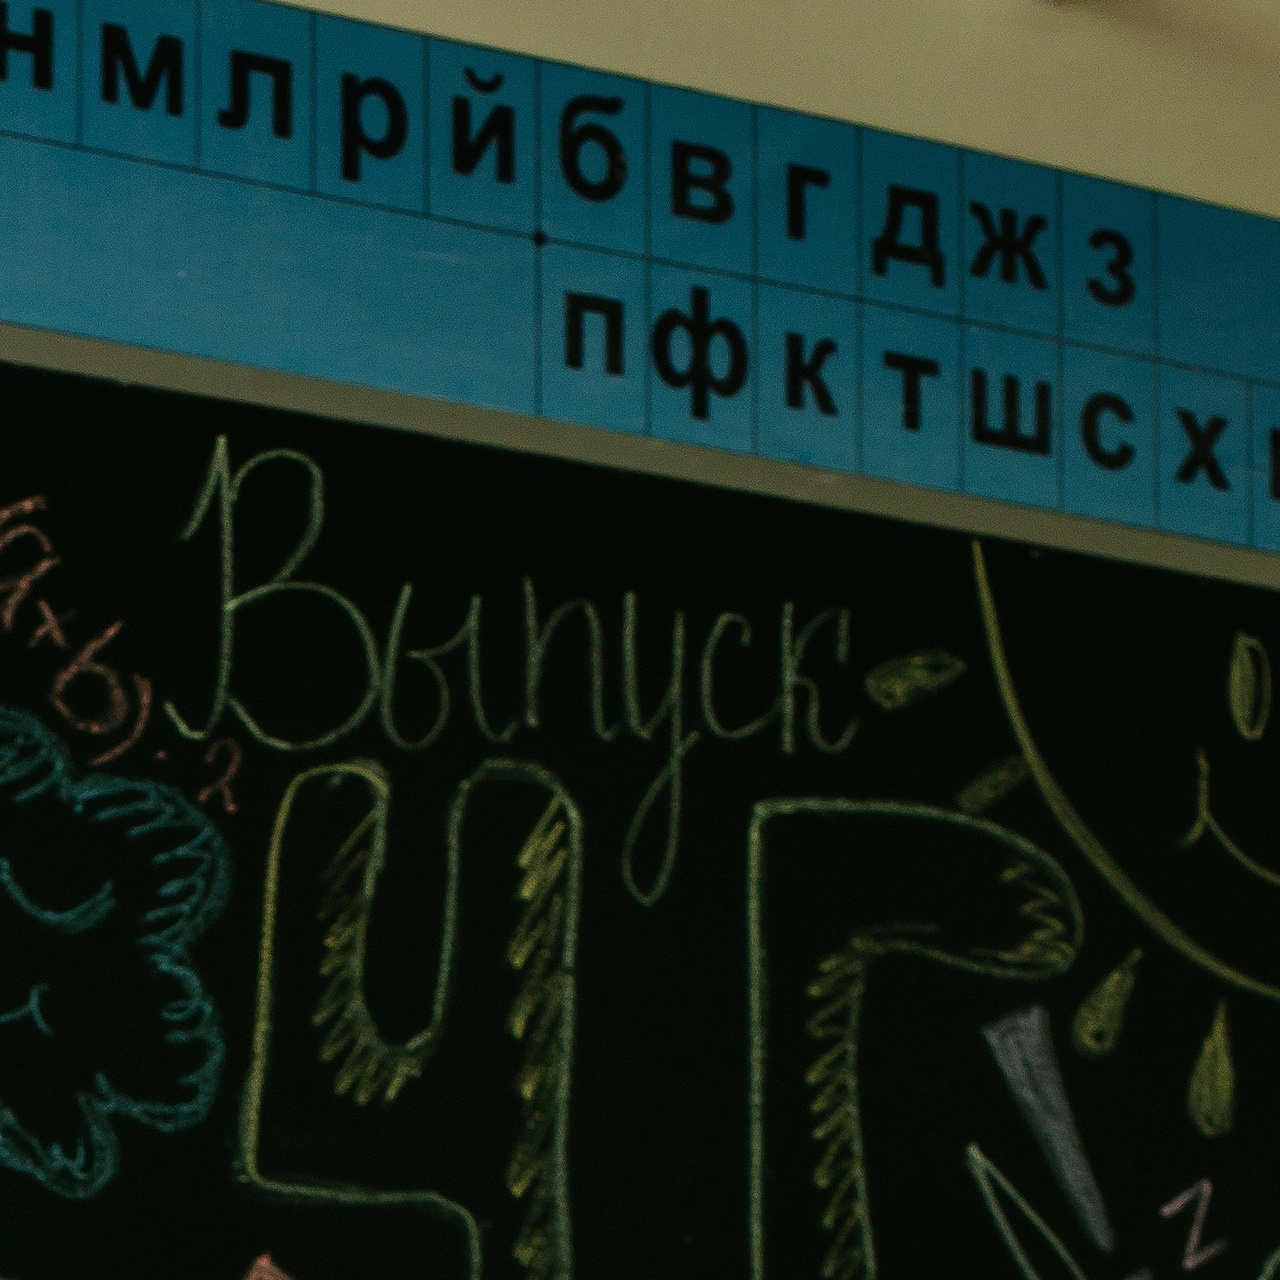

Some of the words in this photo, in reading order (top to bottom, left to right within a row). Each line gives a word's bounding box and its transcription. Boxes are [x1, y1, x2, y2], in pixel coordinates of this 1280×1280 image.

[101, 23, 183, 117] м
[217, 50, 292, 139] л
[340, 73, 408, 182] р
[452, 67, 515, 184] й
[559, 95, 627, 203] б
[671, 141, 734, 224] в
[786, 163, 830, 241] г
[872, 185, 945, 288] д
[970, 202, 1048, 291] ж
[1087, 229, 1136, 307] з
[565, 291, 625, 376] п
[649, 286, 749, 420] ф
[785, 333, 838, 416] к
[883, 351, 940, 430] т
[971, 369, 1051, 455] ш
[1080, 393, 1135, 471] с
[1176, 410, 1230, 491] х
[163, 433, 860, 905] Выпуск
